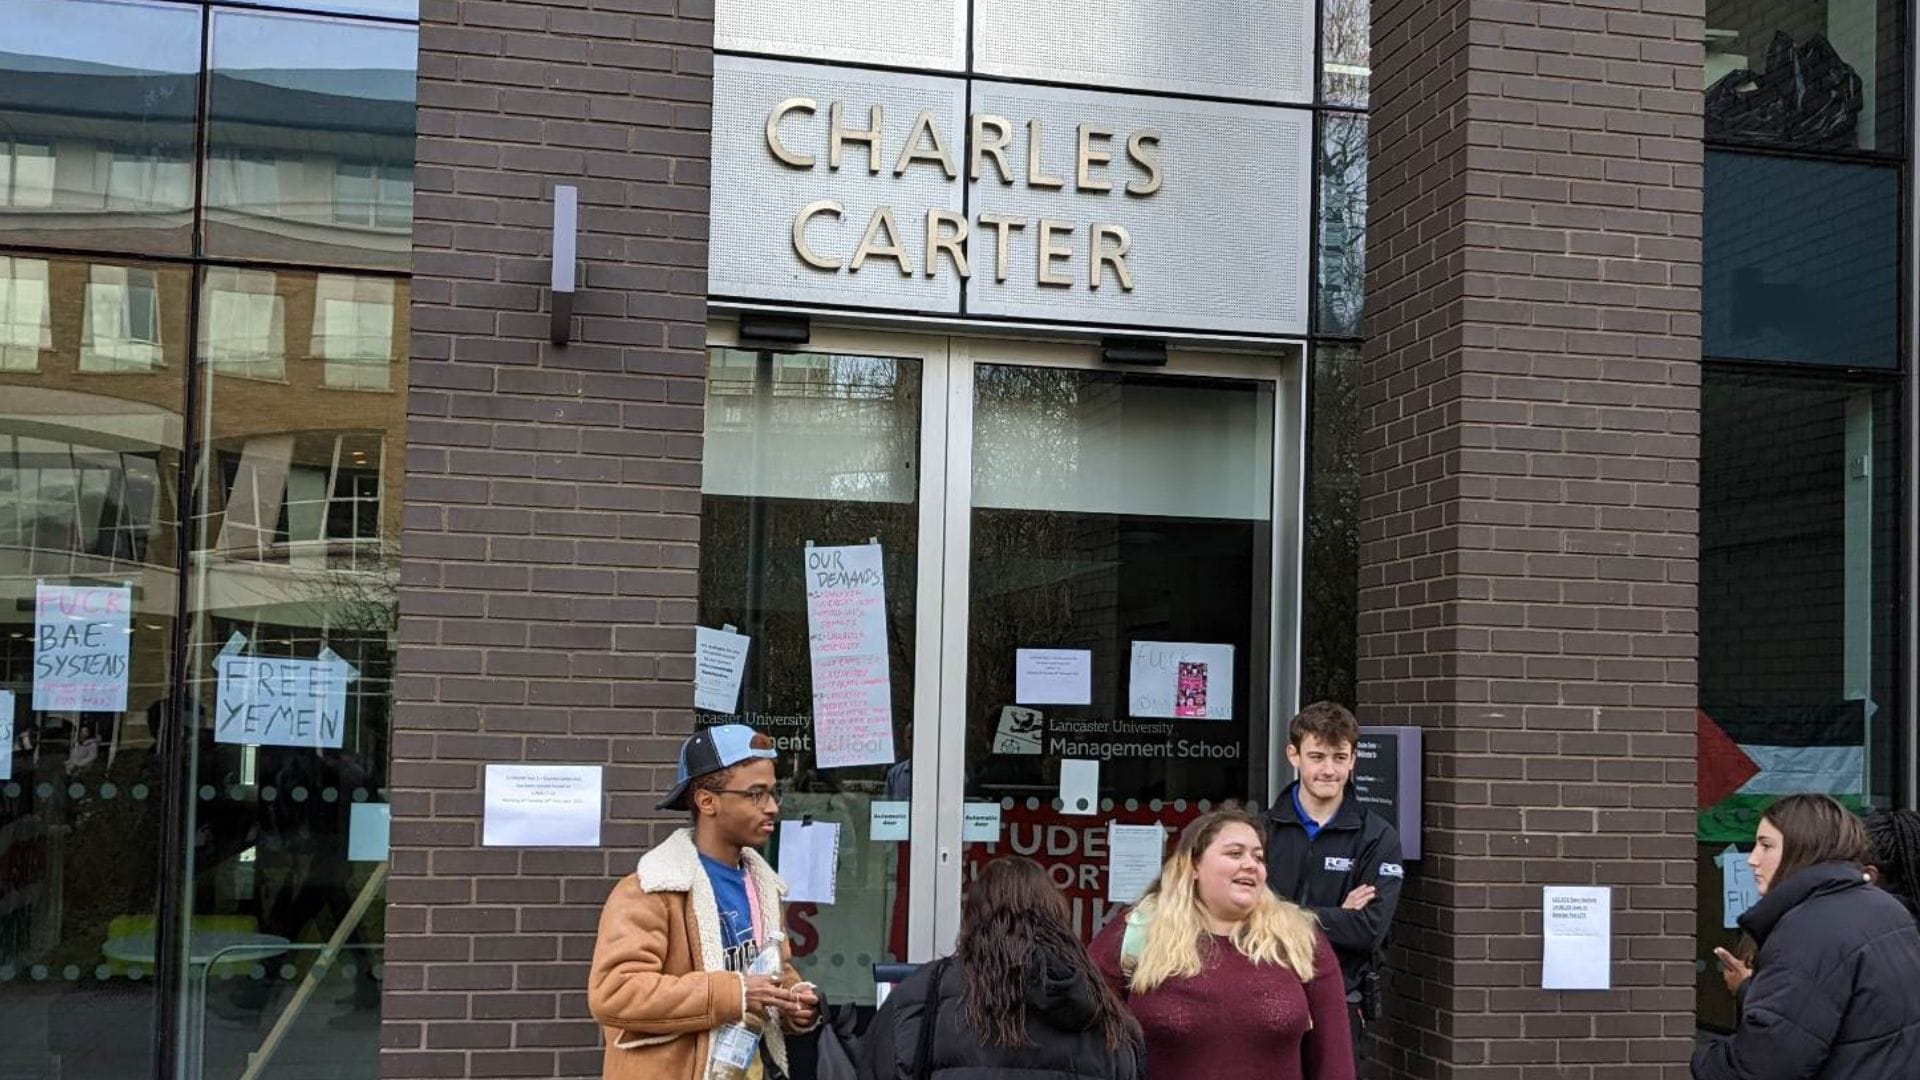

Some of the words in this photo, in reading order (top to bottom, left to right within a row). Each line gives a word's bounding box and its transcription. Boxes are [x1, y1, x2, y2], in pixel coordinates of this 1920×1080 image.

[766, 97, 1163, 197] CHARLES
[792, 199, 1134, 291] CARTER
[808, 550, 845, 571] OUR
[37, 589, 127, 617] FUCK
[39, 621, 107, 652] B.A.E.
[224, 660, 333, 699] FREE
[218, 699, 339, 740] YEMEN
[745, 712, 812, 728] University
[1049, 718, 1109, 733] Lancaster
[1112, 720, 1175, 735] University
[1049, 736, 1174, 760] Management
[1177, 739, 1241, 759] School
